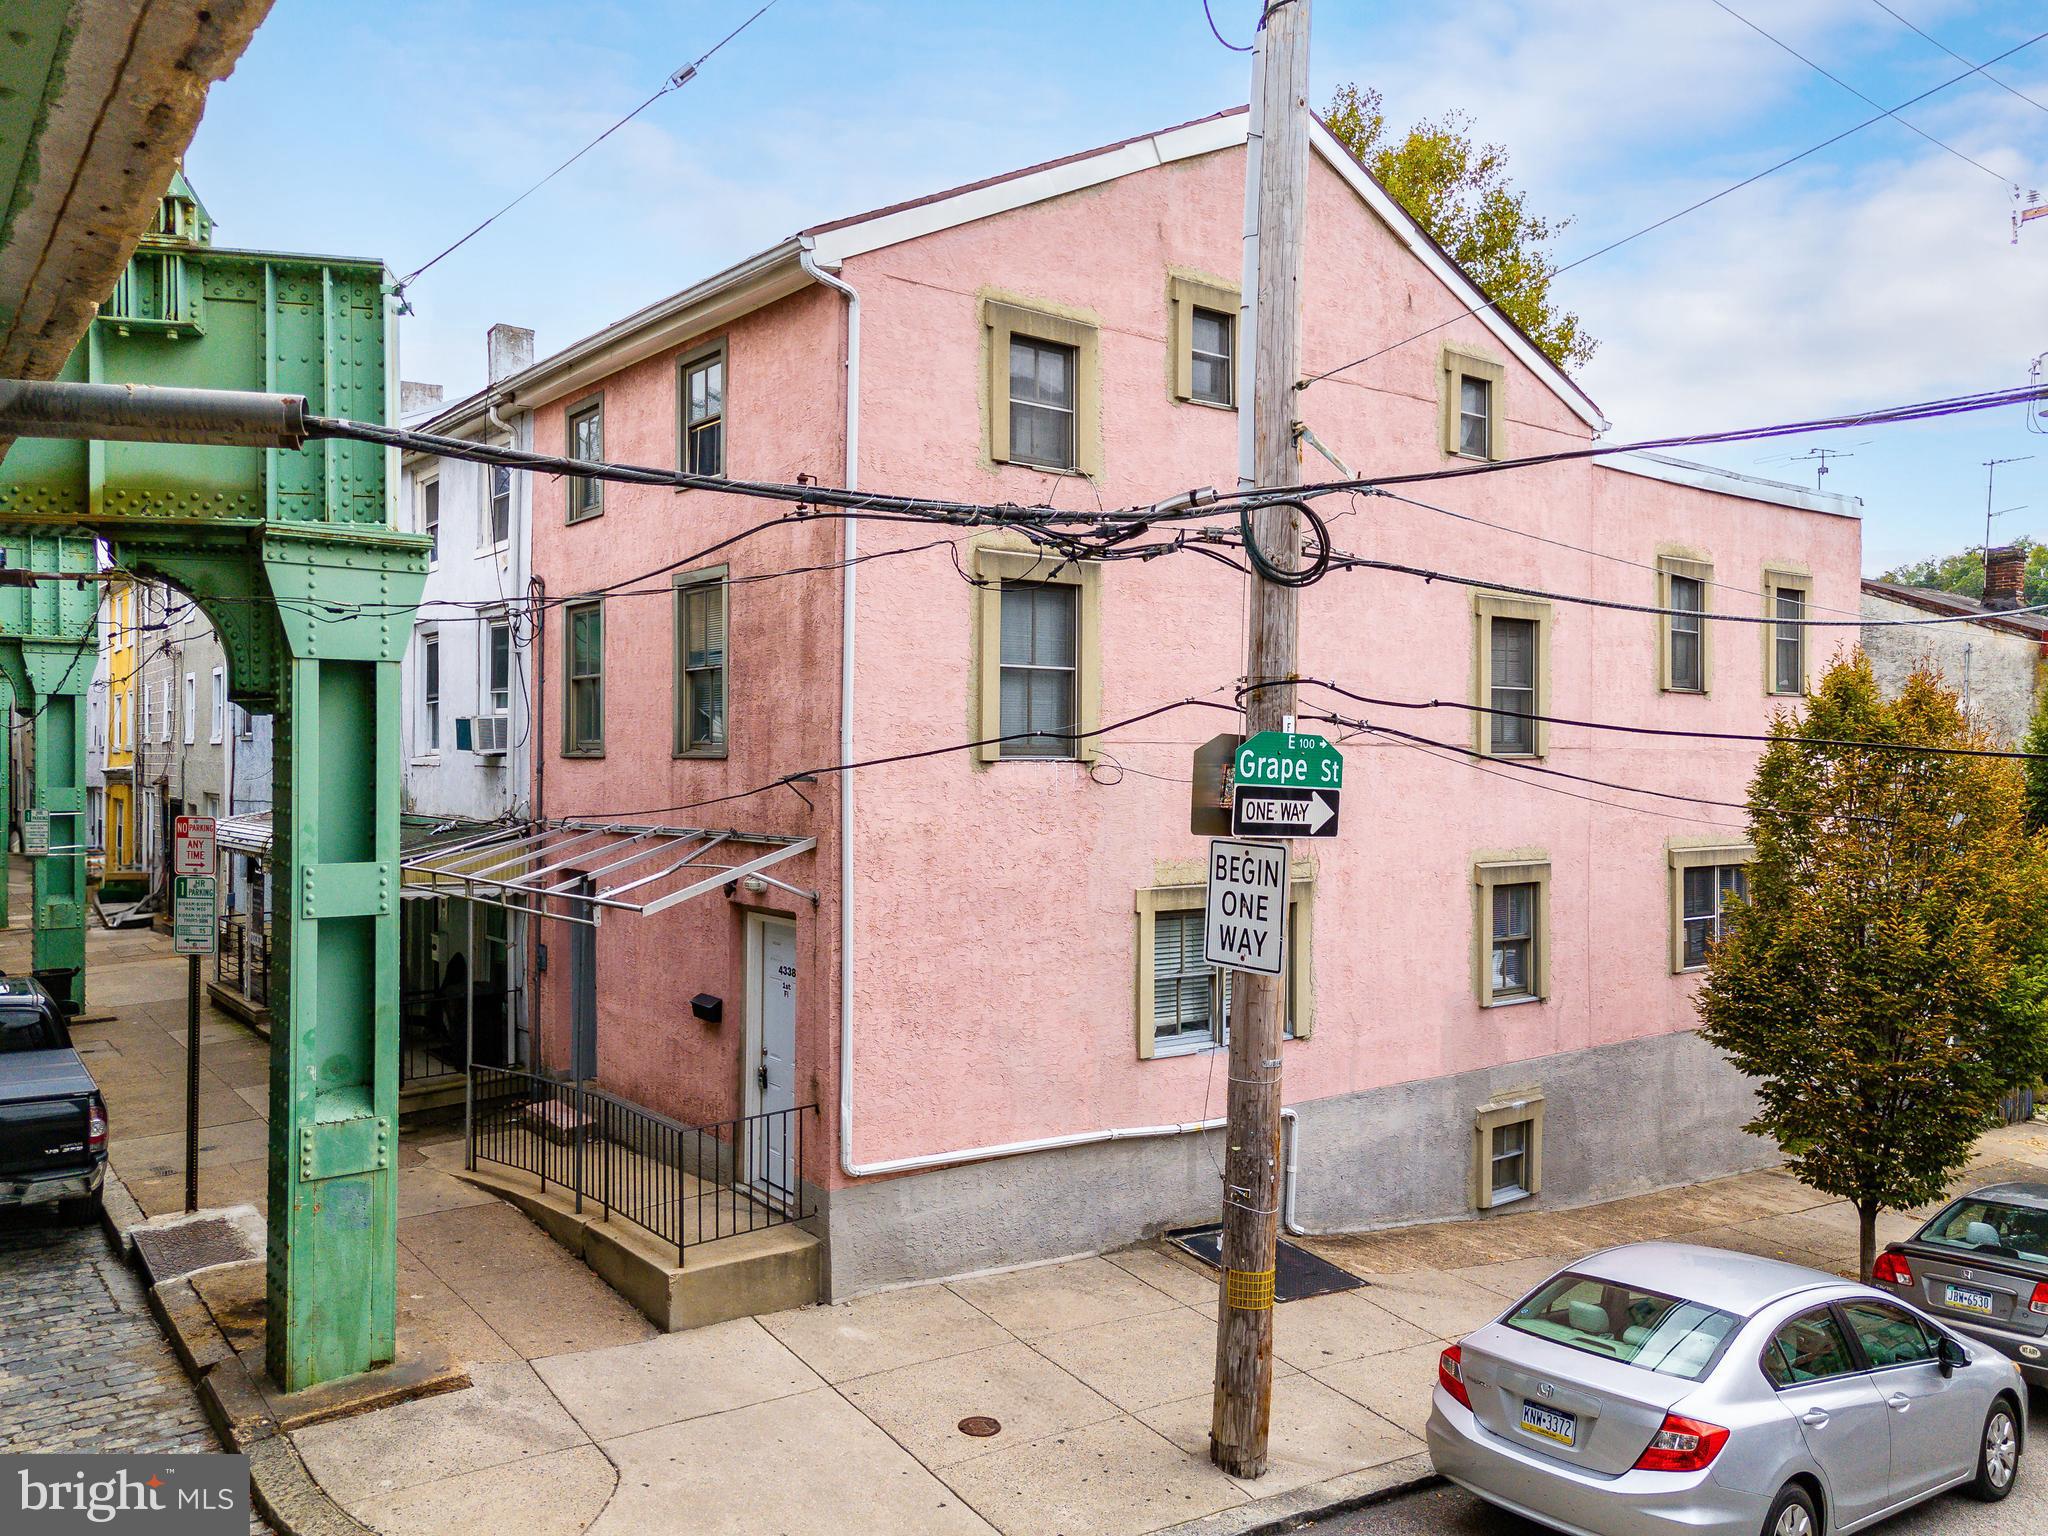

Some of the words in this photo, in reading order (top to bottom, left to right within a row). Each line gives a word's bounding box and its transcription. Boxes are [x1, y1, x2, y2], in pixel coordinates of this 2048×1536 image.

[1288, 735, 1295, 749] E
[1300, 739, 1315, 749] 100
[1240, 750, 1308, 784] Grape
[1321, 759, 1339, 783] St
[1246, 801, 1275, 821] ONE
[1280, 803, 1309, 822] WAY
[177, 822, 188, 833] NO
[188, 824, 214, 832] PARKING
[187, 840, 205, 850] ANY
[186, 850, 205, 860] TIME
[1216, 854, 1279, 888] BEGIN
[180, 881, 185, 896] 1
[195, 880, 206, 888] HR
[189, 889, 213, 897] PARKING
[1222, 891, 1269, 922] ONE
[1220, 924, 1268, 957] WAY
[779, 966, 797, 978] 4338
